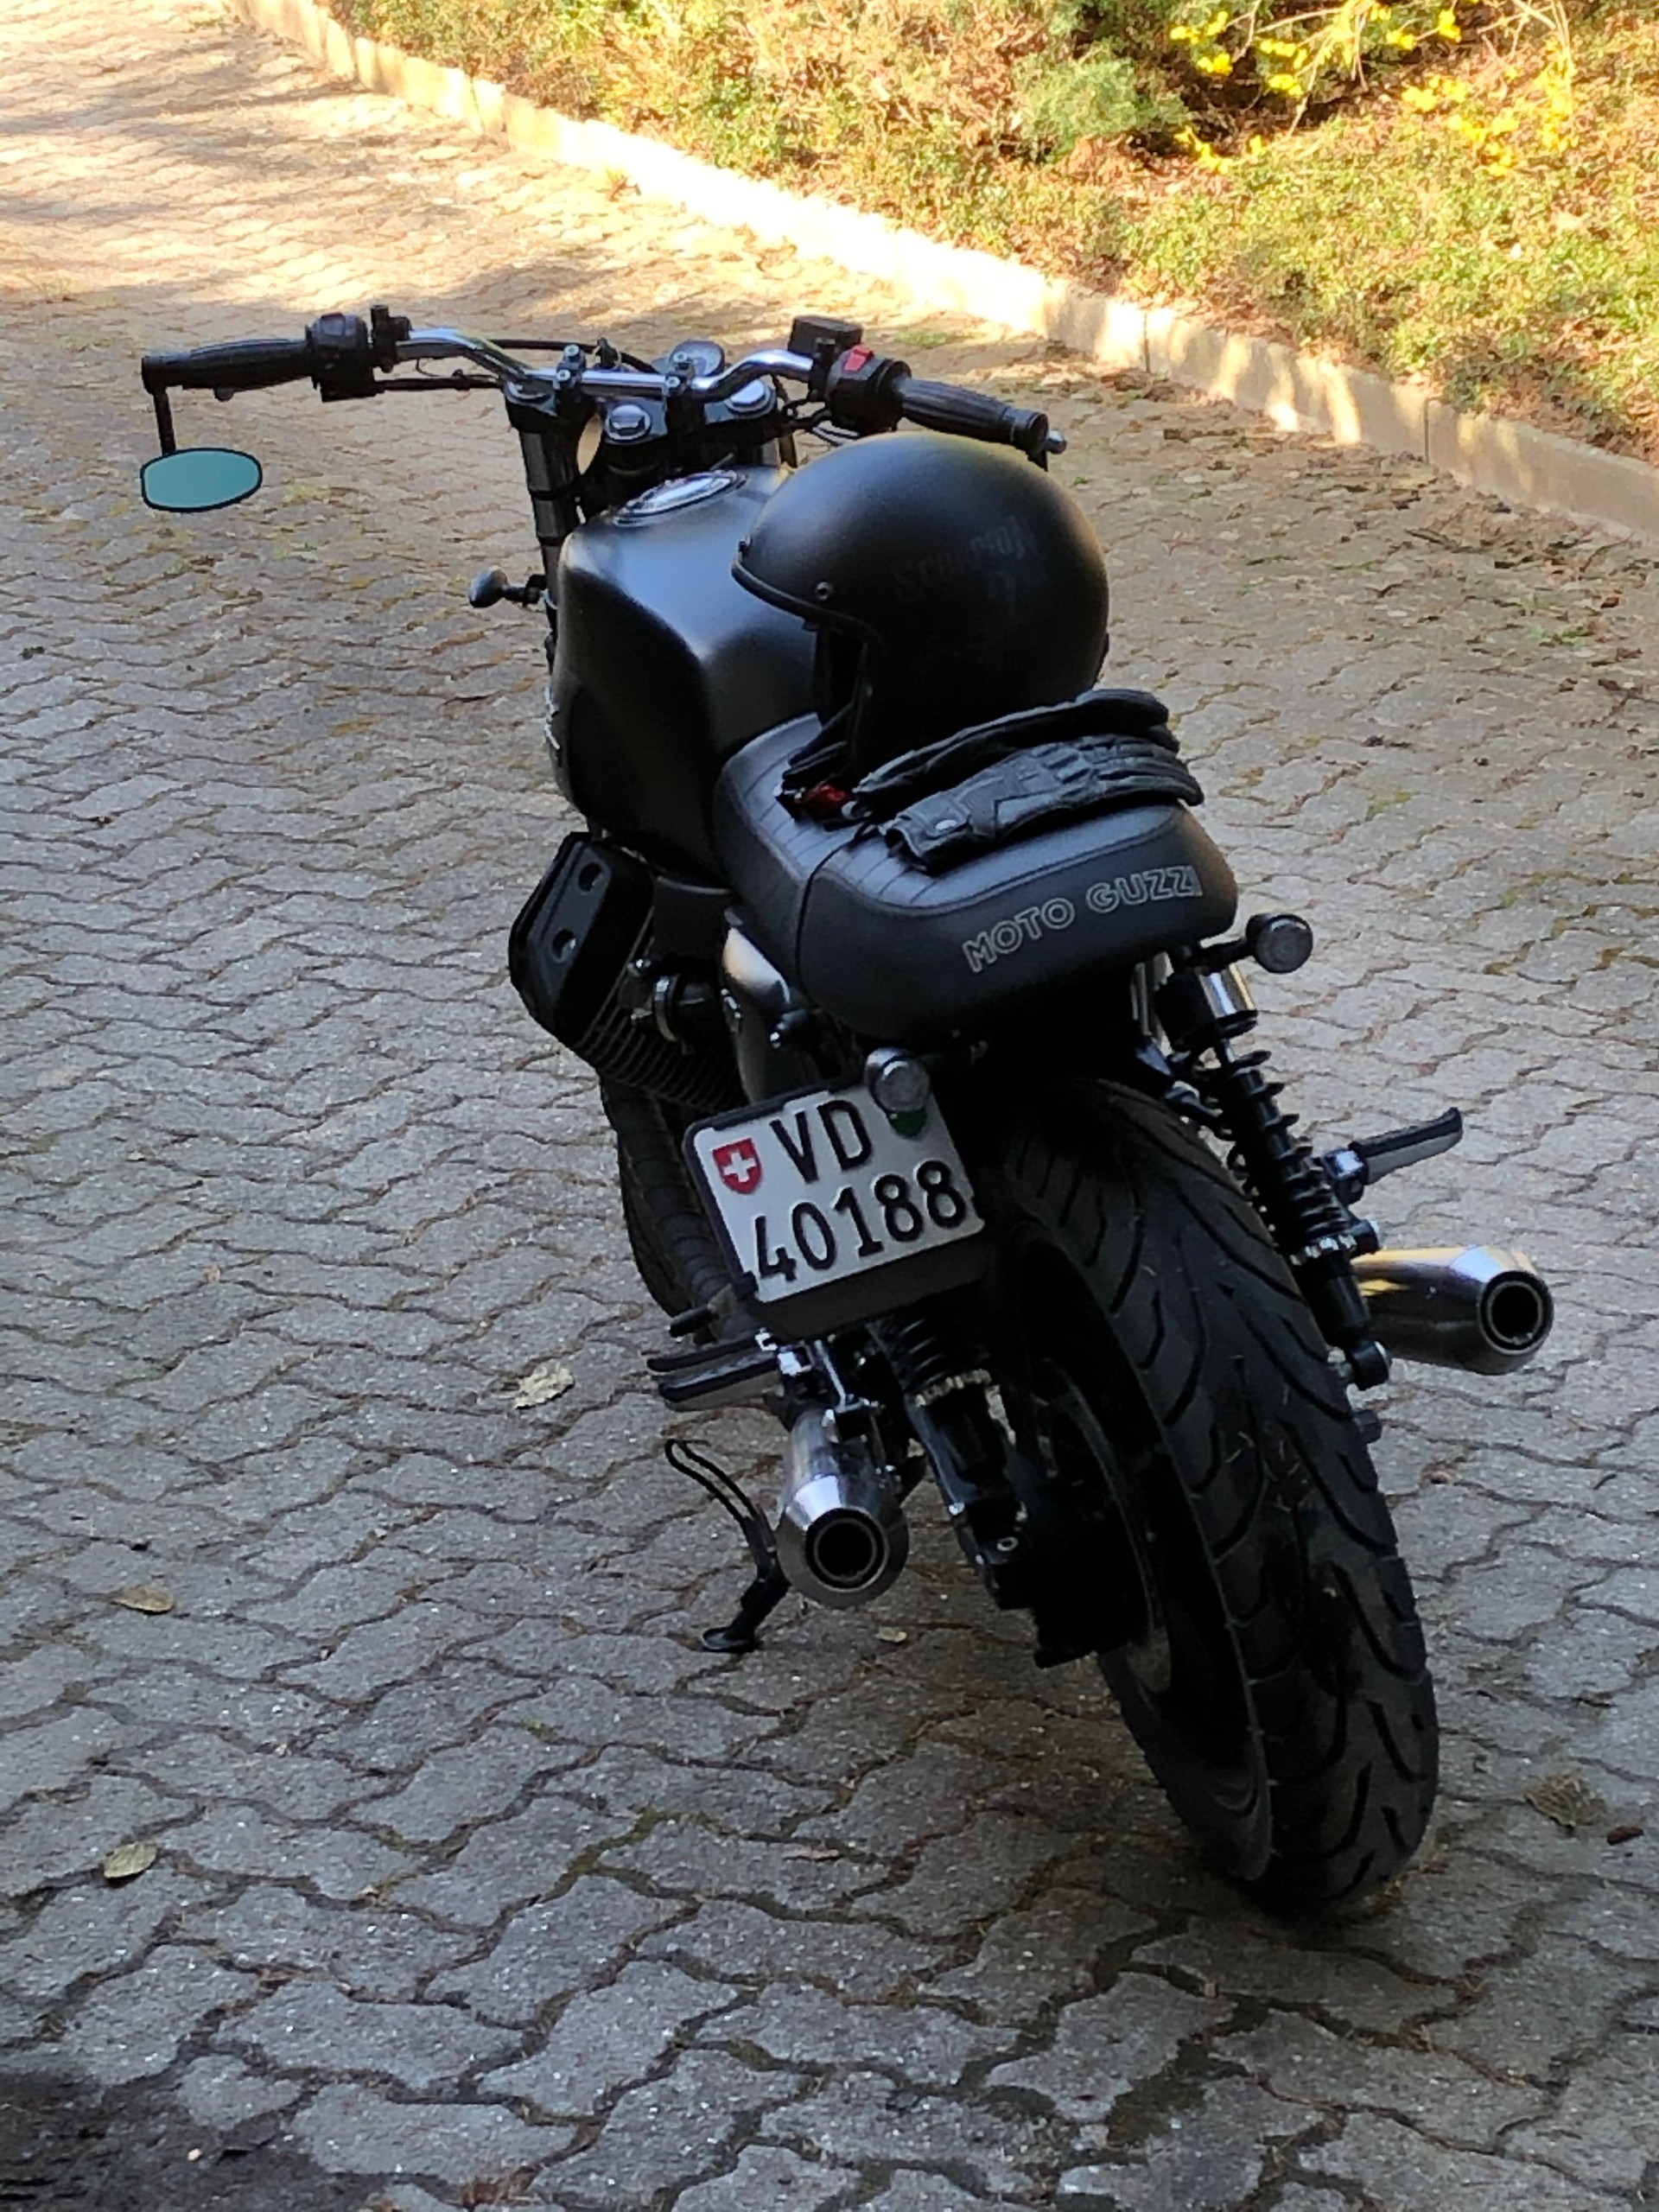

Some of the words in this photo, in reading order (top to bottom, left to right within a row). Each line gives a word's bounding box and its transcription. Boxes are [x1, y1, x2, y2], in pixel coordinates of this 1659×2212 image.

[962, 897, 1076, 972] MOTO
[769, 1100, 873, 1184] VD
[754, 1160, 967, 1282] 40188
